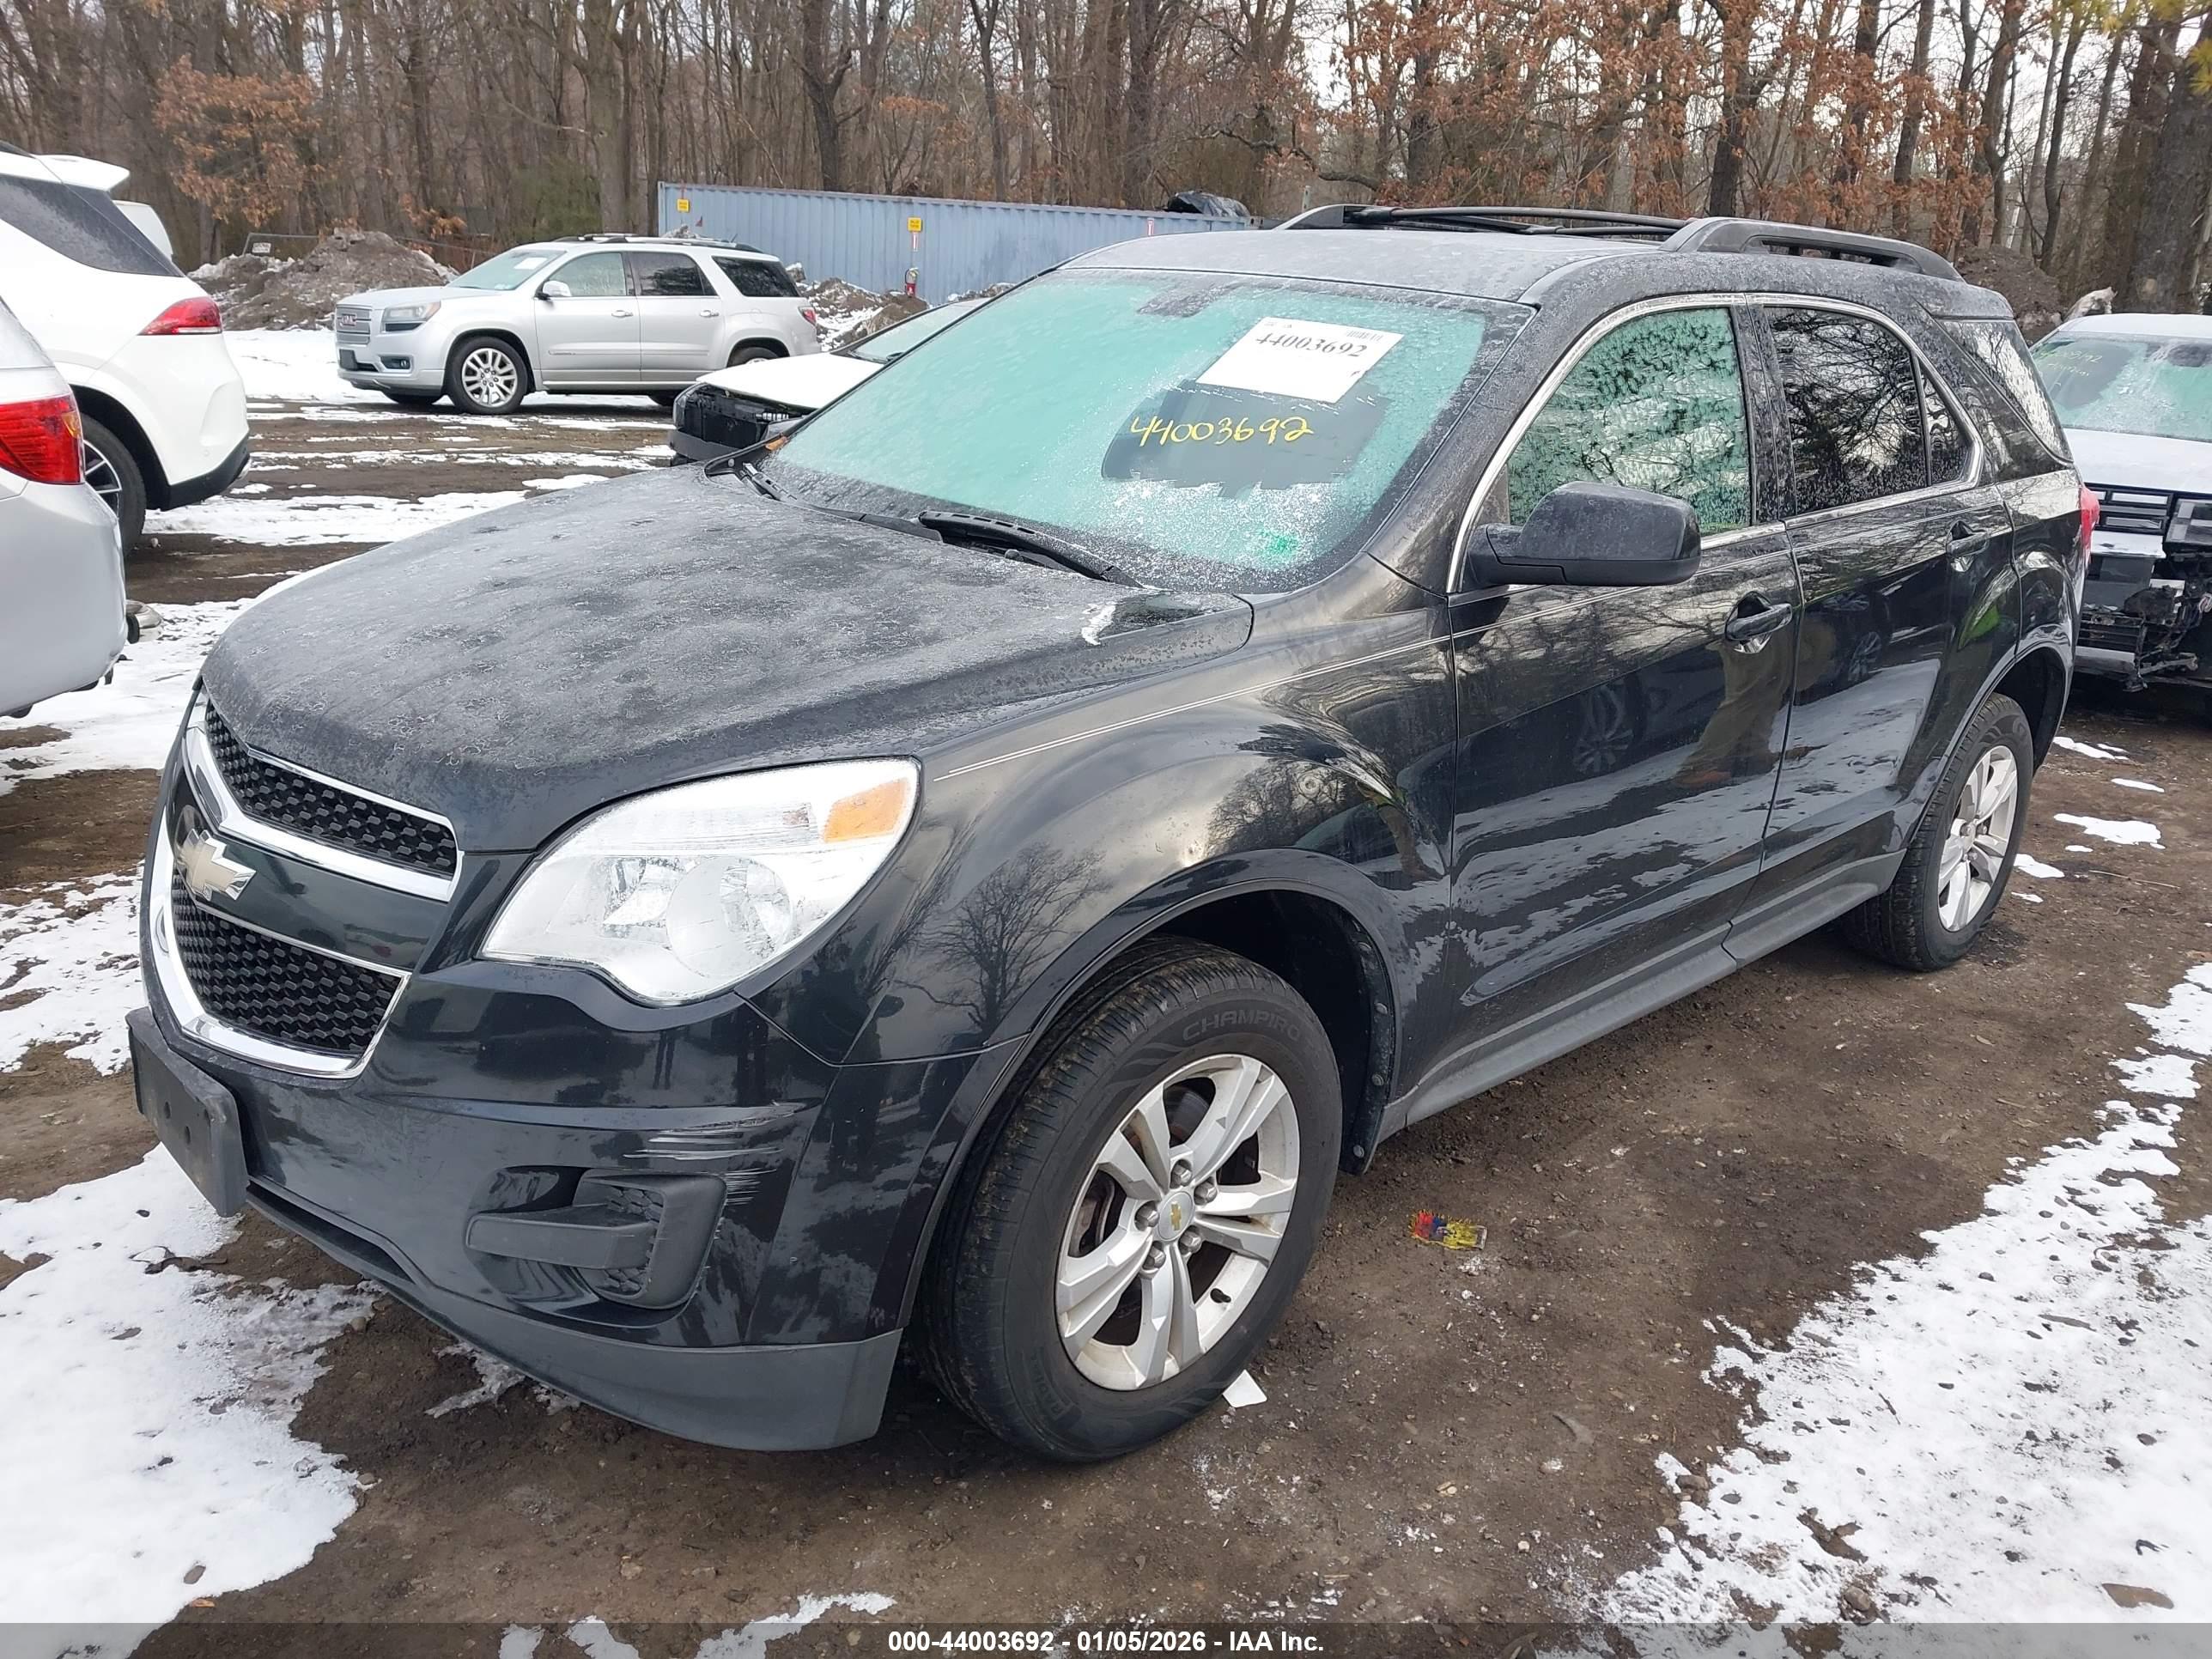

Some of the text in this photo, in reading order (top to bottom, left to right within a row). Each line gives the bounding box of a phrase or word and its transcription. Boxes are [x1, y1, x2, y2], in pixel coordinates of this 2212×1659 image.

[1256, 332, 1368, 357] 44003692
[1130, 416, 1313, 447] 44003692
[1182, 1009, 1301, 1042] CHAMPIRO
